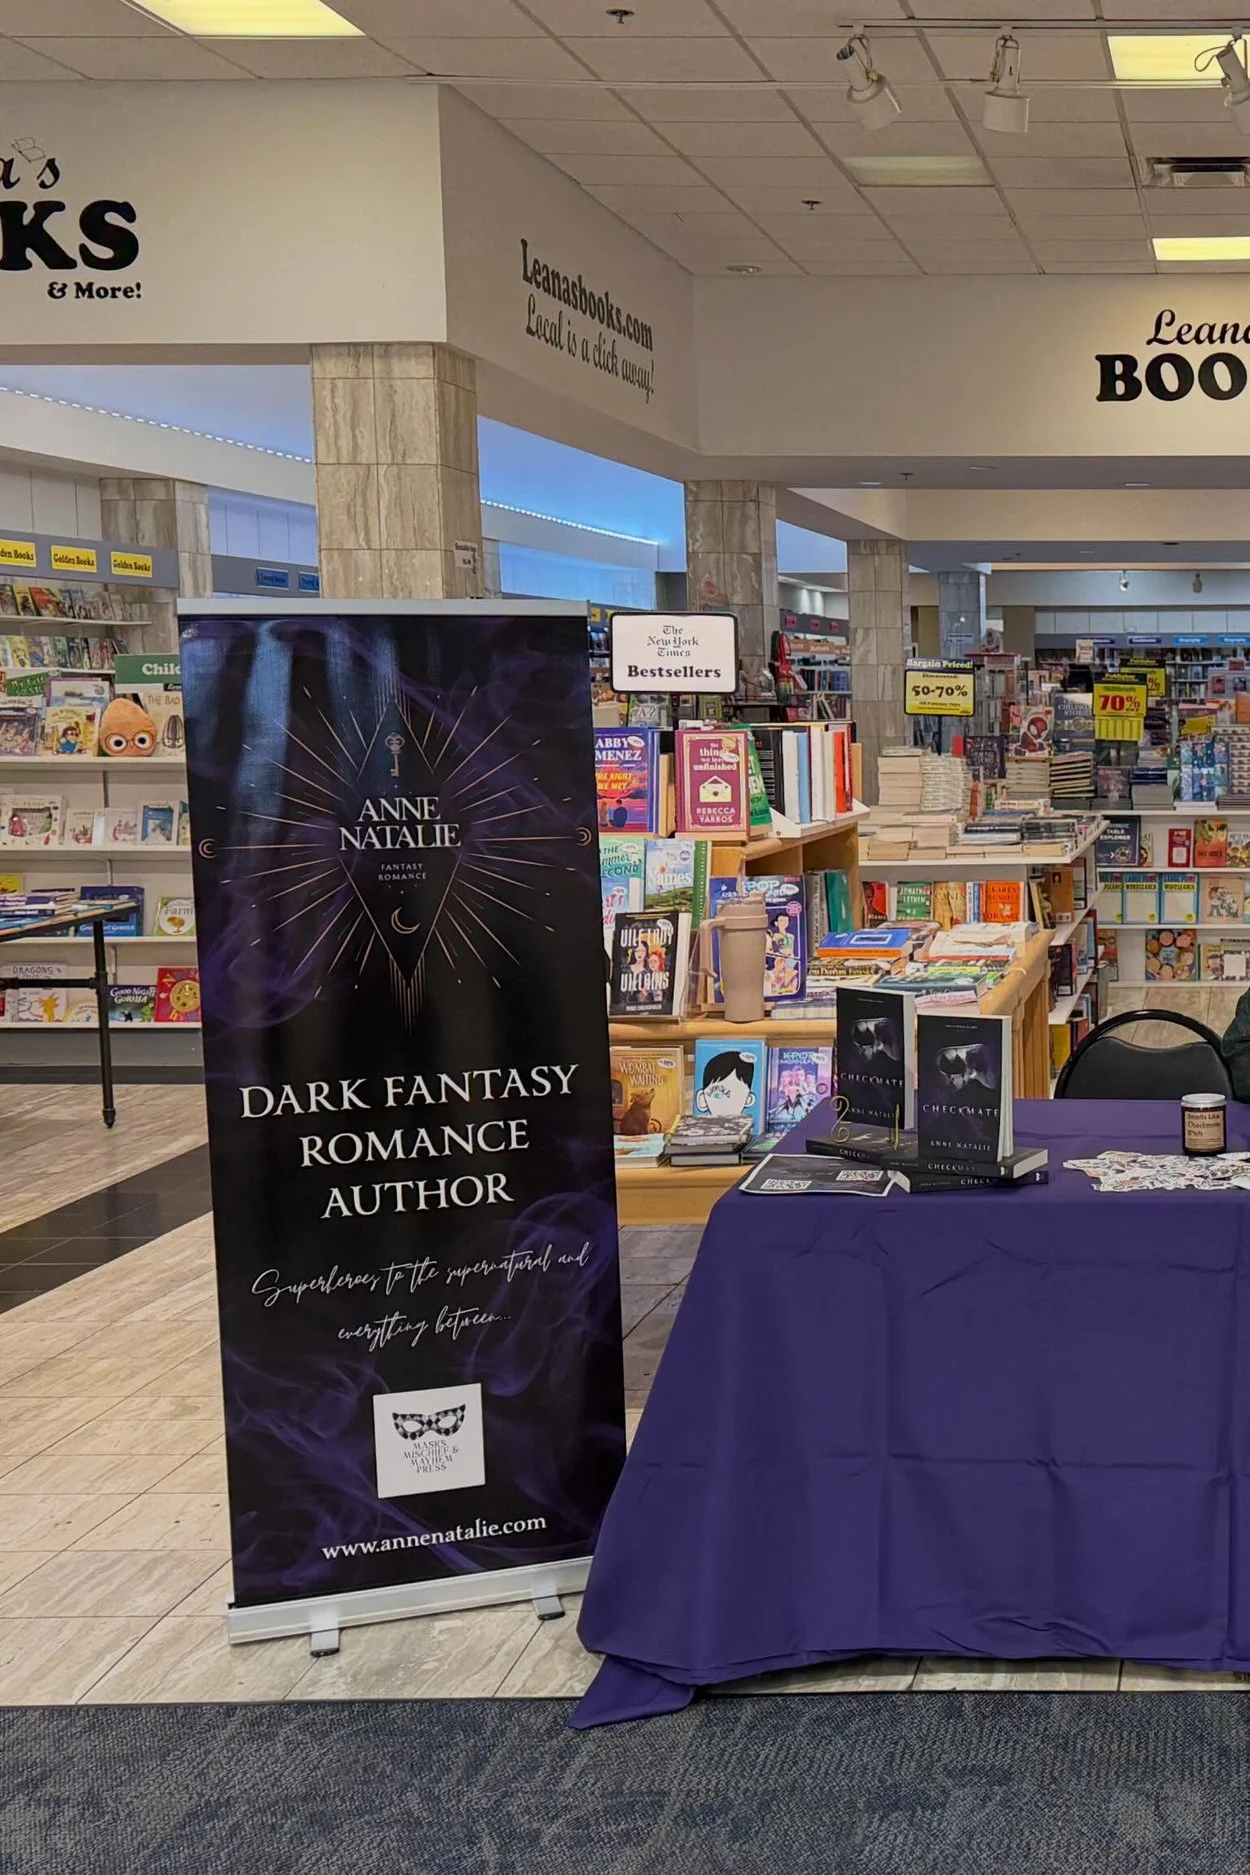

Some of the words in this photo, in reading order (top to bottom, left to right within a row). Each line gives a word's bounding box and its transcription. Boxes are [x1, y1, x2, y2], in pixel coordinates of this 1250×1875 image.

[47, 281, 67, 299] &
[74, 281, 142, 299] More!
[521, 239, 653, 351] Leanasbooks.com
[526, 294, 564, 350] Local
[567, 320, 577, 357] is
[581, 338, 590, 363] a
[593, 332, 619, 377] click
[622, 358, 654, 403] away!
[53, 553, 75, 565] Golden
[76, 556, 95, 567] Books
[663, 625, 683, 635] The
[647, 636, 671, 646] New
[673, 636, 699, 649] York
[657, 647, 691, 657] Times
[906, 659, 941, 668] Bargain
[943, 660, 973, 668] Priced!
[627, 665, 722, 678] Bestsellers
[912, 685, 968, 698] 50-70%
[595, 750, 642, 761] MENEZ
[693, 763, 737, 771] unfinished
[358, 797, 441, 822] ANNE
[696, 807, 736, 815] REBECCA
[699, 815, 733, 823] YARROS
[339, 824, 461, 851] NATALIE
[381, 863, 423, 871] FANTASY
[378, 872, 427, 881] ROMANCE
[840, 1072, 904, 1088] CHECKMATE
[239, 1078, 370, 1119] DARK
[383, 1064, 579, 1108] FANTASY
[923, 1104, 1000, 1117] CHECKMATE
[299, 1119, 530, 1168] ROMANCE
[930, 1140, 951, 1148] ANNE
[956, 1143, 991, 1152] NATALIE
[320, 1173, 514, 1219] AUTHOR
[252, 1265, 381, 1307] Superheroes
[381, 1262, 413, 1295] to
[405, 1257, 439, 1293] the
[445, 1244, 552, 1284] supernatural
[558, 1241, 590, 1267] and
[338, 1311, 430, 1352] everything
[321, 1516, 547, 1559] www.annenatalie.com
